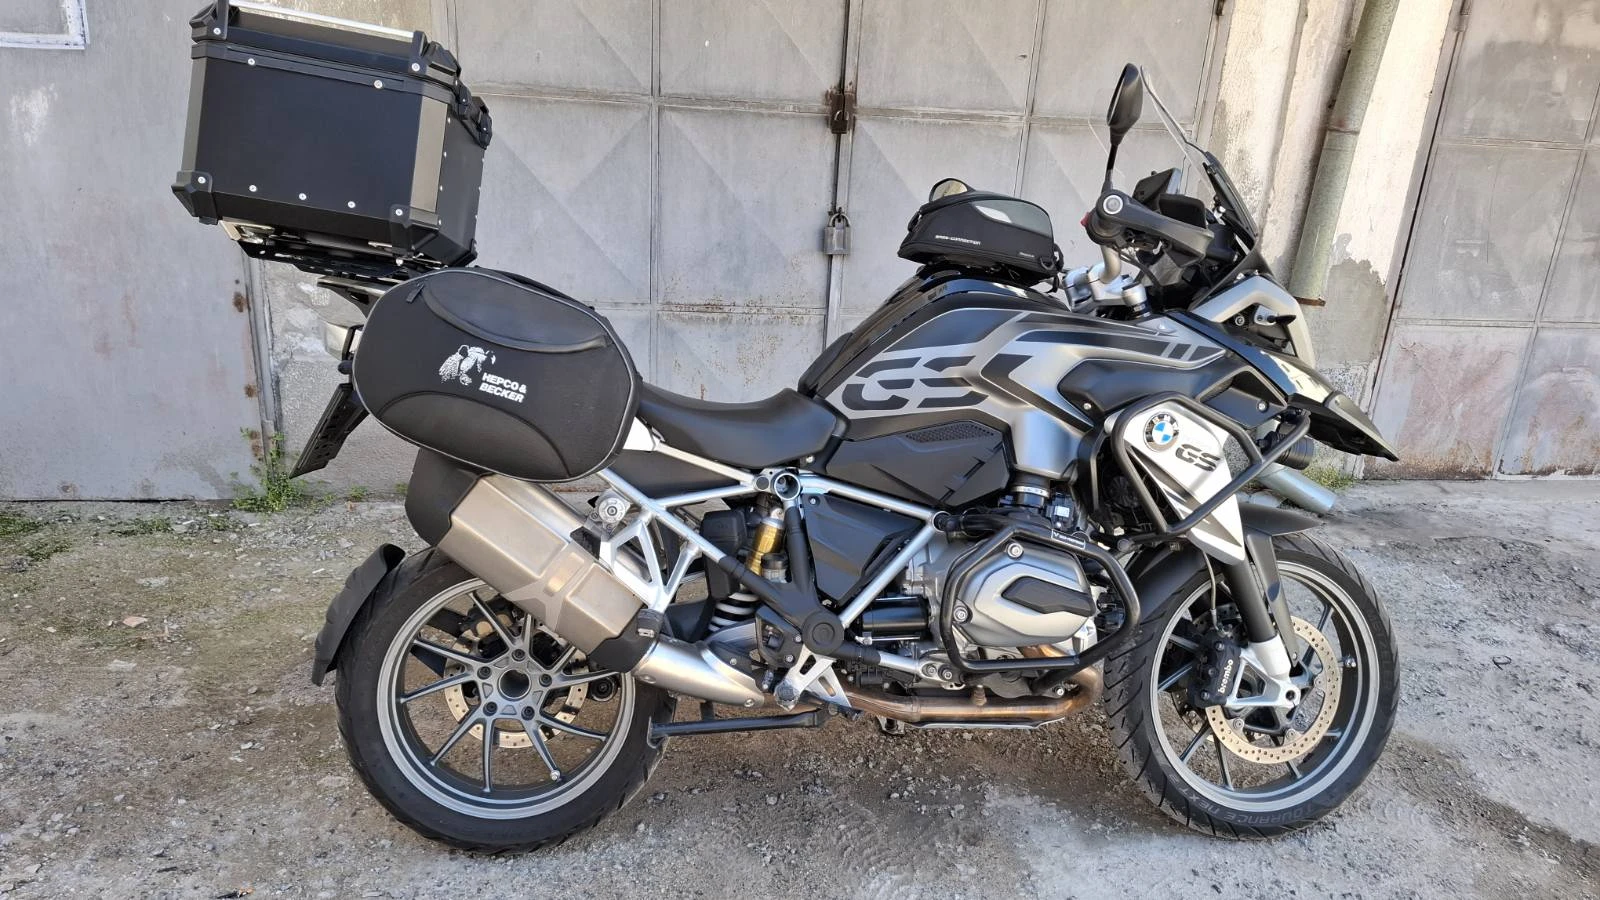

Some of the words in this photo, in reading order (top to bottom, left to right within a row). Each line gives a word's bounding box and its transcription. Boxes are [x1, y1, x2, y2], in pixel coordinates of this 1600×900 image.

[479, 382, 524, 403] BECKER
[482, 372, 519, 391] HEPCO
[842, 356, 989, 411] GS
[1175, 443, 1221, 472] GS
[1217, 659, 1234, 694] brembo
